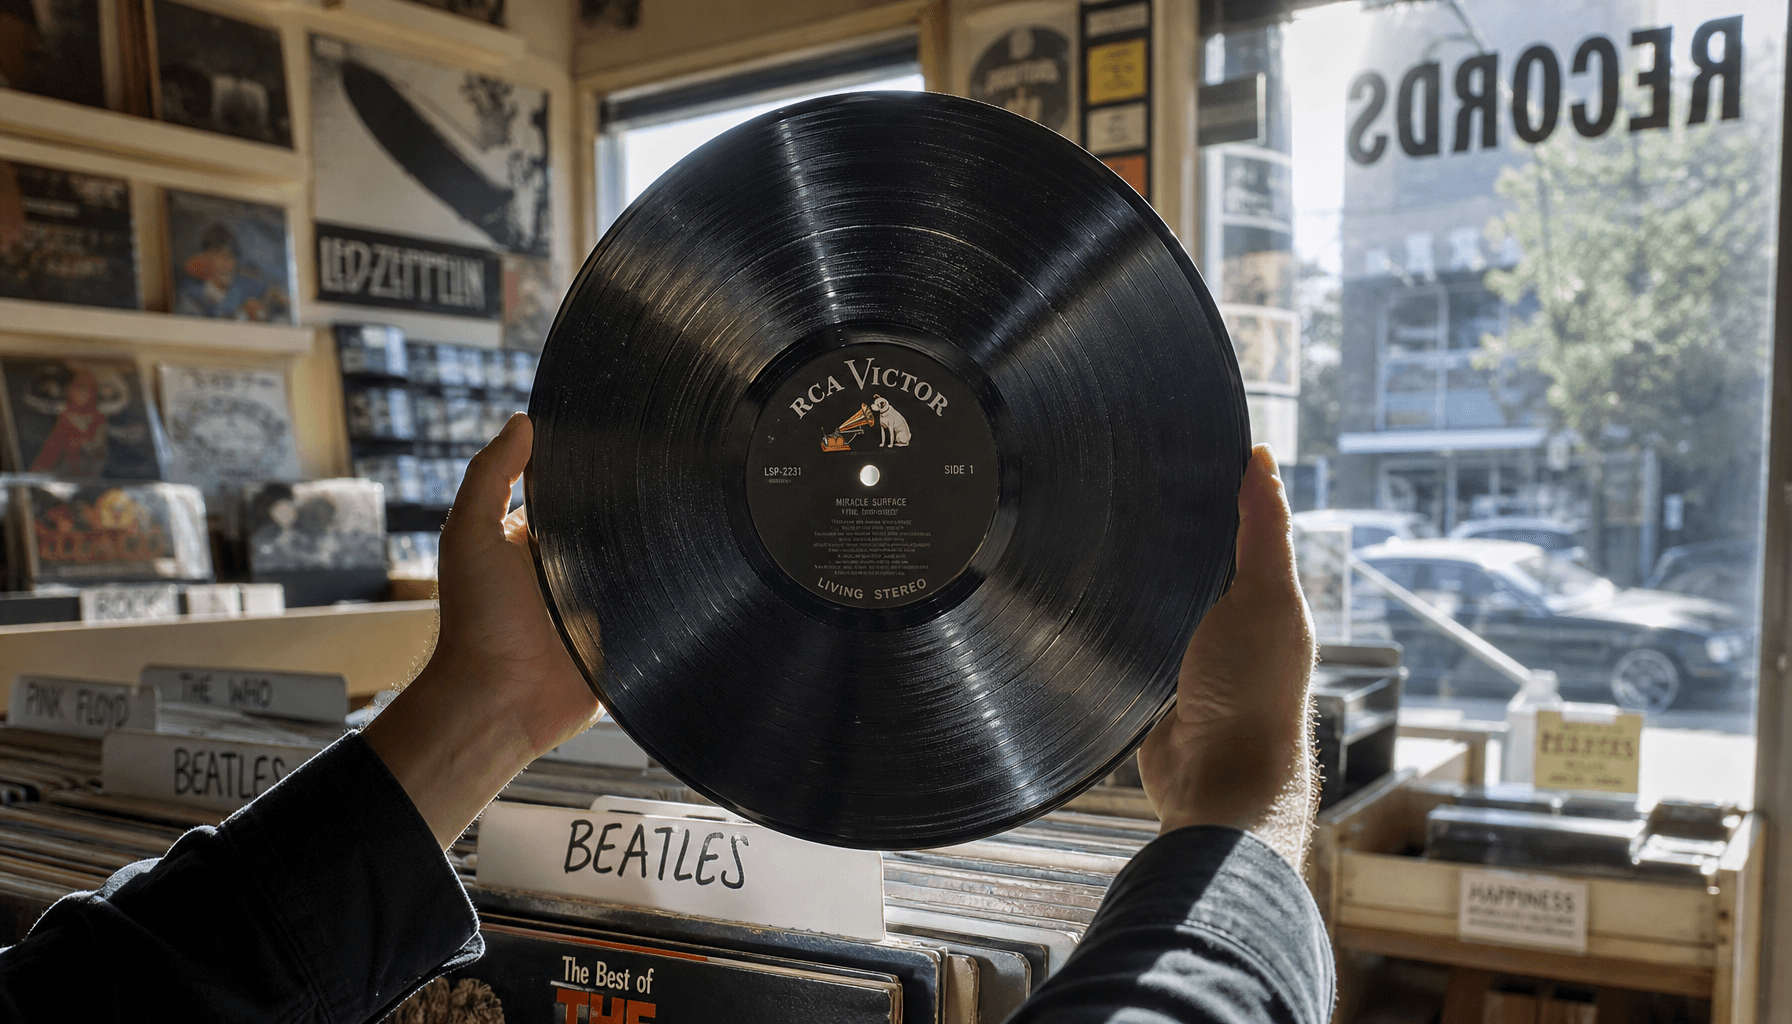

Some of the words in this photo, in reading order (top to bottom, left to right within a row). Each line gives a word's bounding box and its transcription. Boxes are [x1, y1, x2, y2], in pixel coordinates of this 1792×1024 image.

[789, 375, 845, 419] RCA
[844, 357, 949, 417] VICTOR
[764, 466, 802, 477] LSP-2231
[944, 465, 965, 475] SIDE
[969, 465, 974, 475] 1
[835, 498, 869, 507] MIRACLE
[872, 498, 907, 507] SURFACE
[817, 577, 864, 599] LIVING
[874, 578, 927, 600] STEREO
[26, 682, 64, 721] PINK
[75, 689, 131, 728] FLOYD
[179, 672, 212, 703] THE
[228, 677, 274, 708] WHO
[564, 819, 749, 889] BEATLES
[1468, 884, 1576, 915] HAPPINESS
[562, 956, 589, 984] The
[596, 961, 630, 991] Best
[636, 967, 654, 994] of
